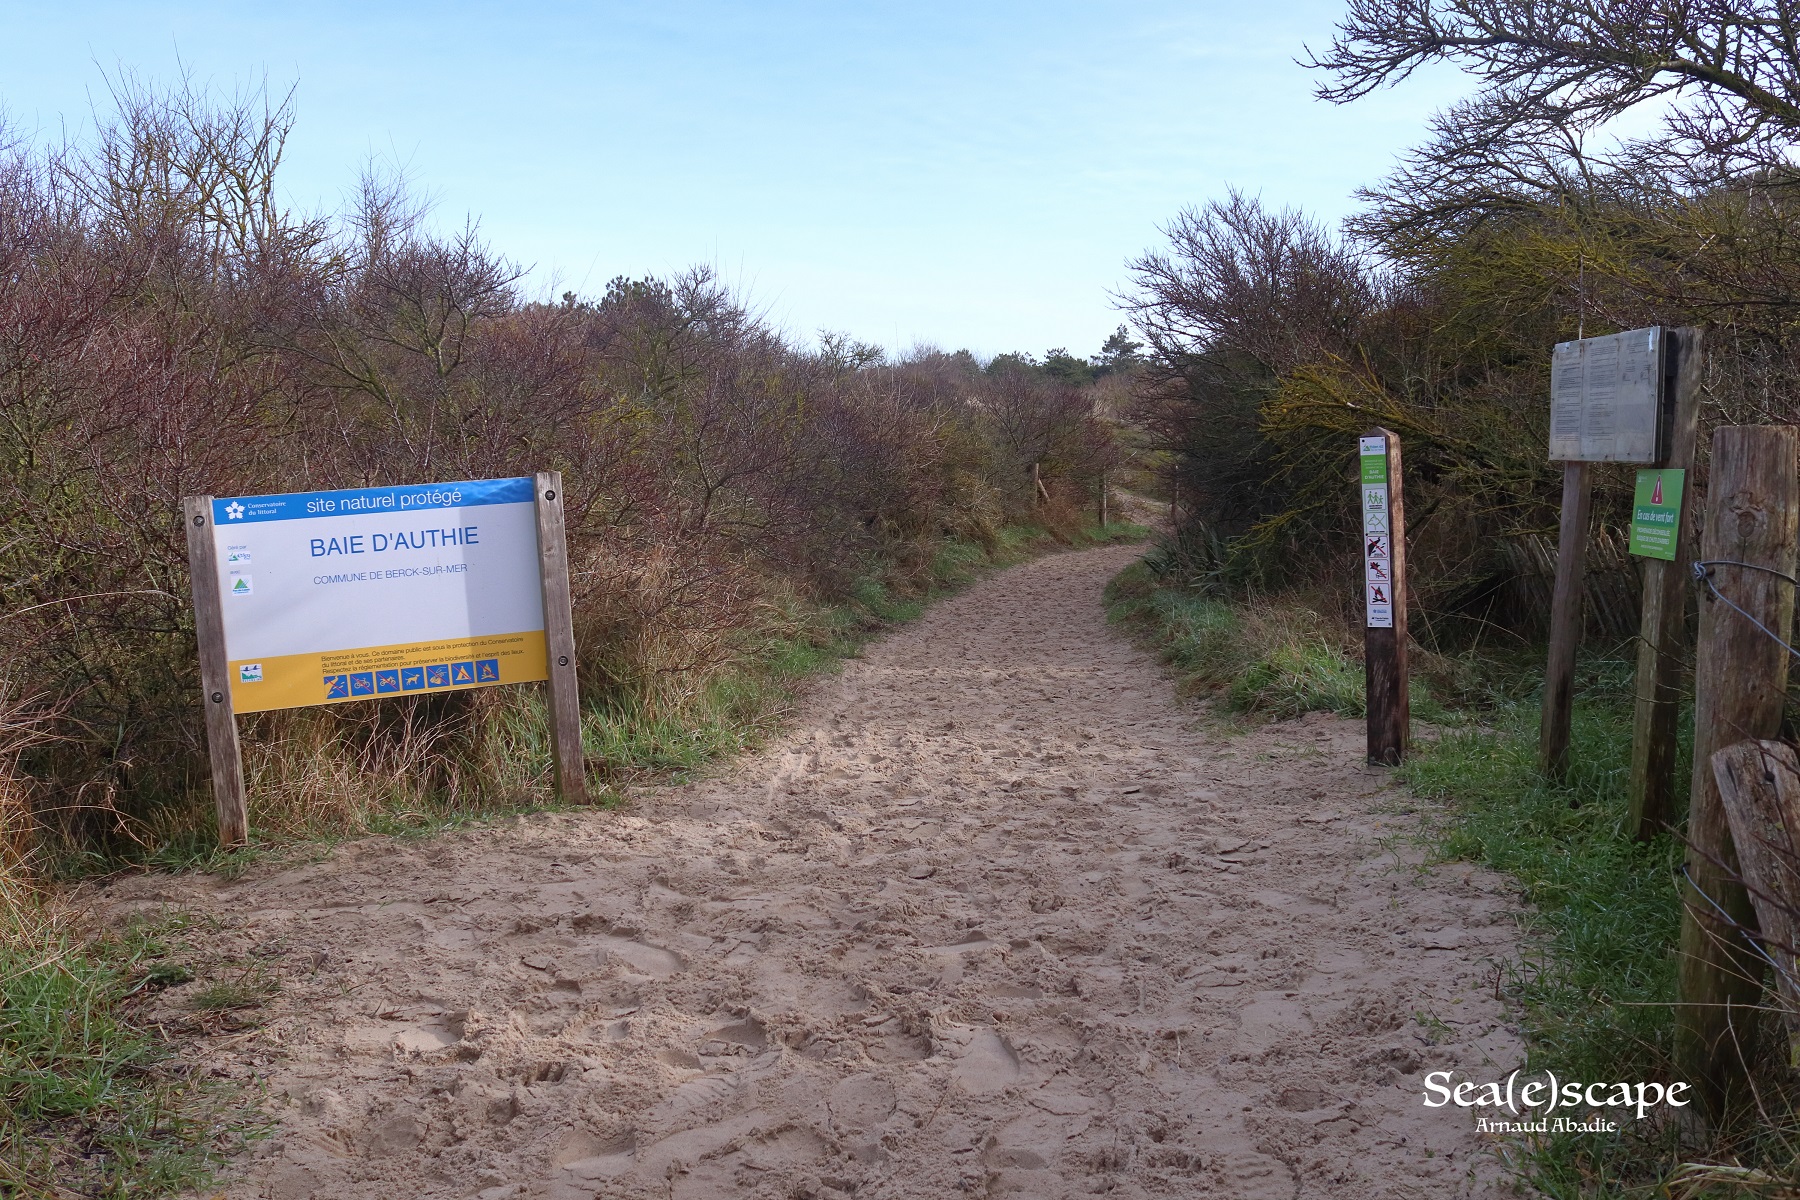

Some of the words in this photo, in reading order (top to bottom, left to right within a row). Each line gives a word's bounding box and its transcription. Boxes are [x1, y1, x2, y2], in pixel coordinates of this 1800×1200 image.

[247, 501, 287, 509] Conservatoire
[307, 498, 335, 513] site
[340, 492, 395, 510] naturel
[401, 488, 462, 509] protégé
[311, 535, 365, 557] BAIE
[372, 526, 480, 553] D'AUTHIE
[313, 571, 367, 585] COMMUNE
[369, 570, 383, 580] DE
[385, 563, 468, 579] BERCK-SUR-MER
[381, 648, 405, 656] domaine
[405, 646, 422, 654] public
[452, 641, 479, 650] protection
[488, 637, 524, 645] Conservatoire
[330, 660, 347, 668] littoral
[359, 662, 399, 671] réglementation
[399, 660, 412, 668] pour
[413, 657, 438, 666] préserver
[445, 653, 475, 661] biodiversité
